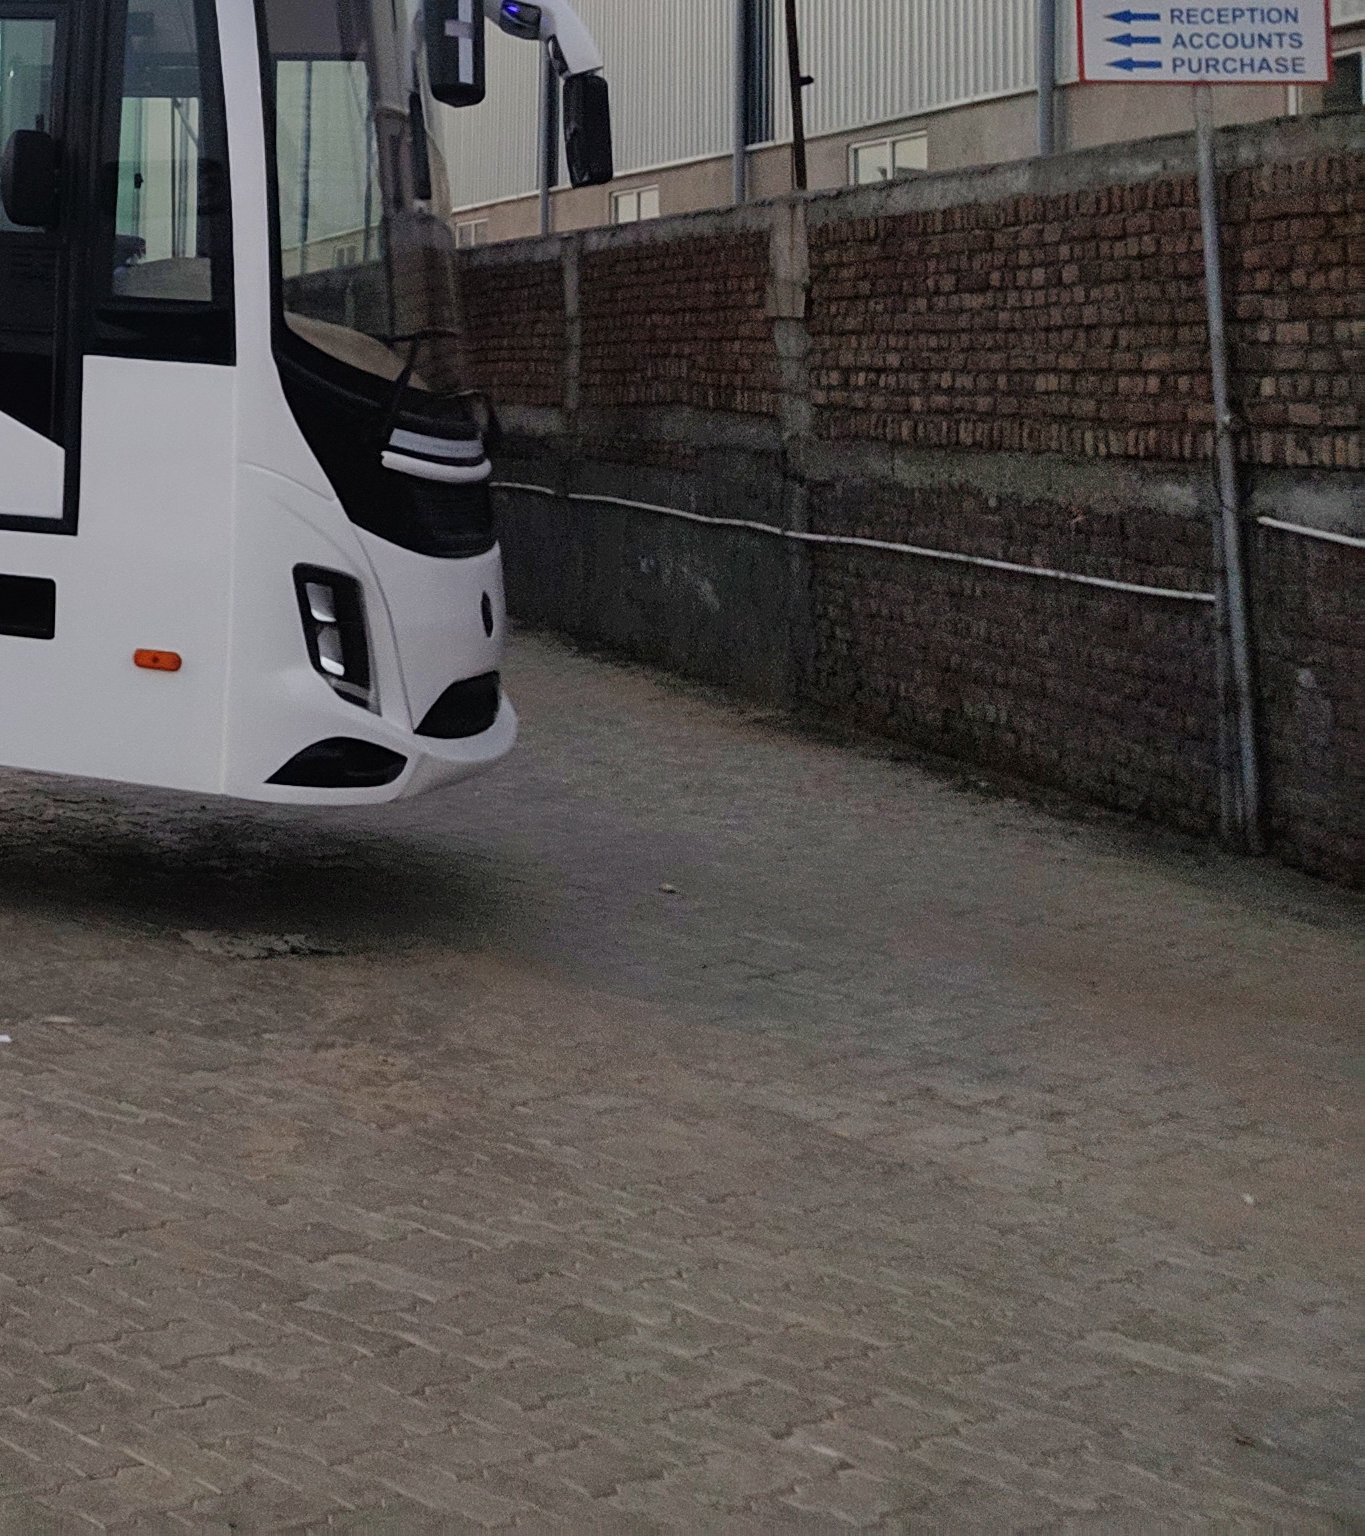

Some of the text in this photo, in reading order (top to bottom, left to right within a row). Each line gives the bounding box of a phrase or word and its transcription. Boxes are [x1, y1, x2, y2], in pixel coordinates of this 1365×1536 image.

[1170, 7, 1300, 25] RECEPTION
[1172, 32, 1304, 49] ACCOUNTS
[1172, 57, 1306, 75] PURCHASE
